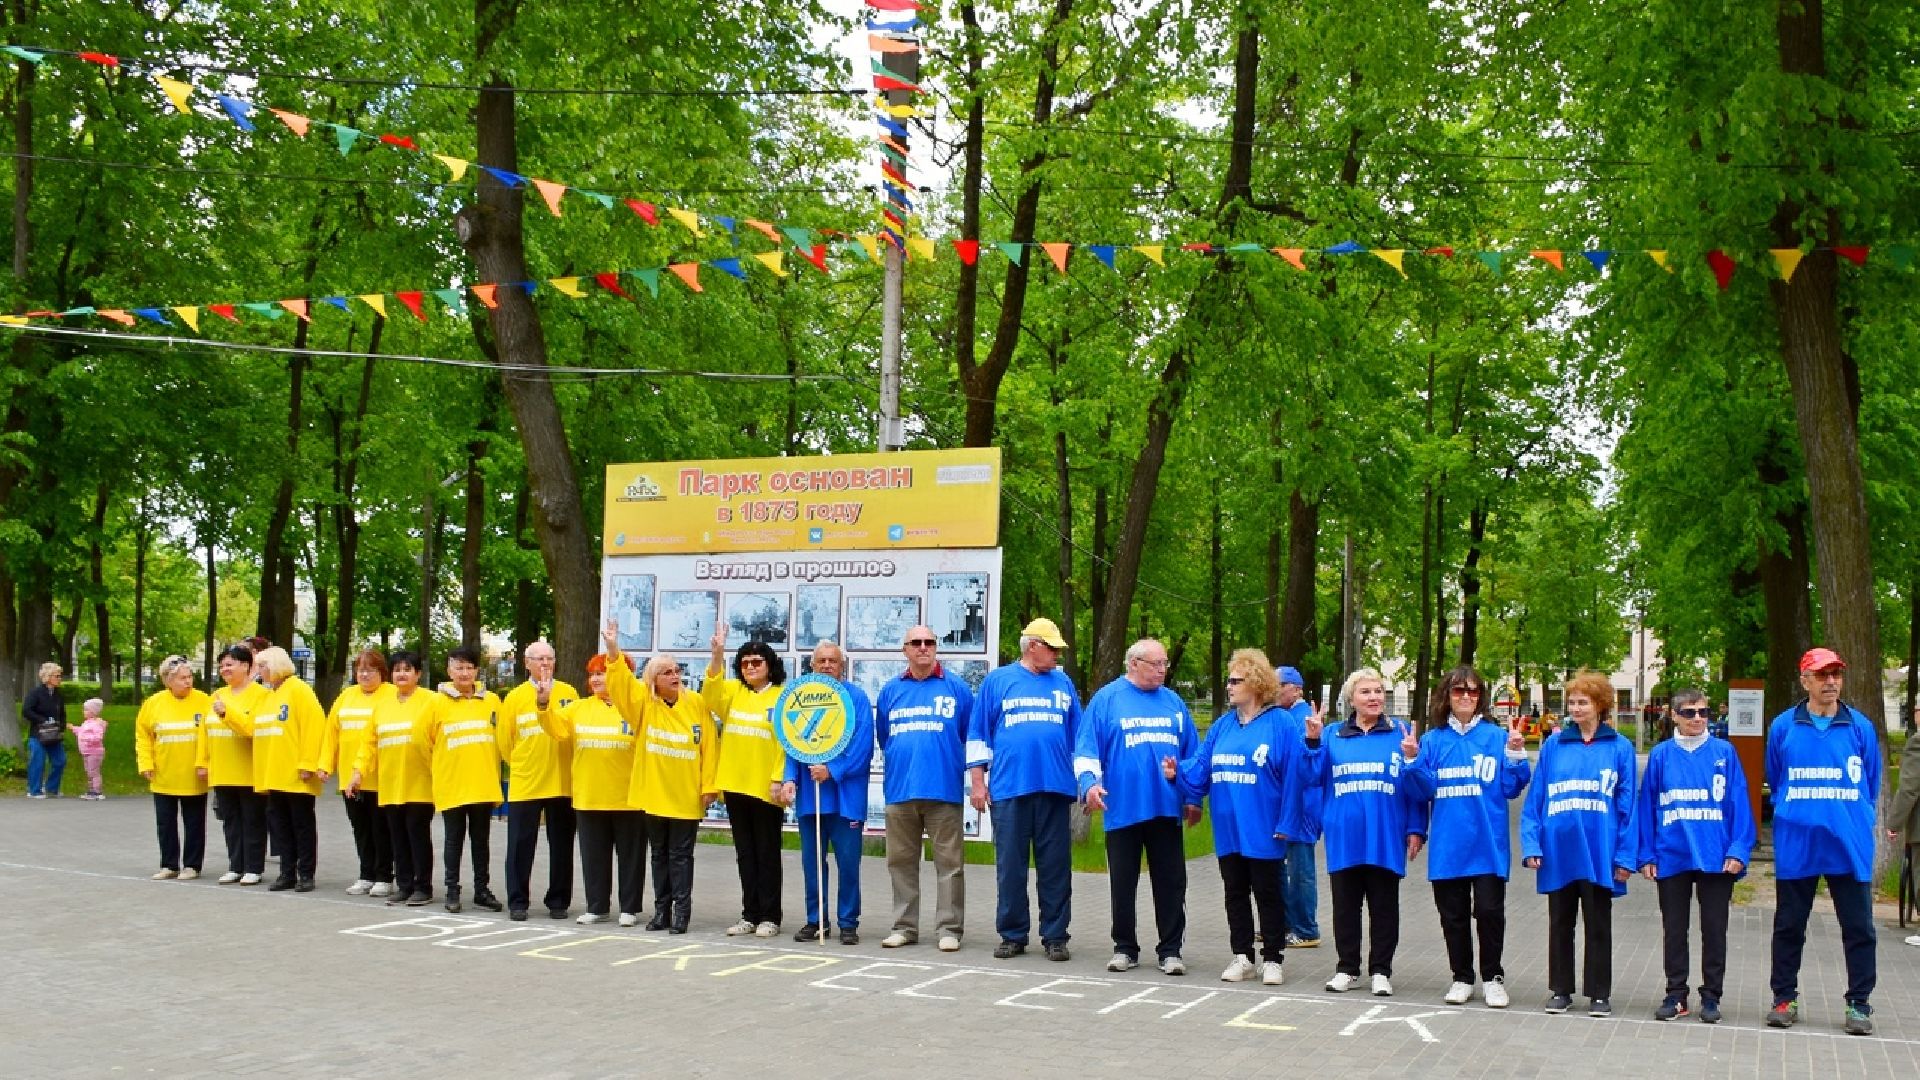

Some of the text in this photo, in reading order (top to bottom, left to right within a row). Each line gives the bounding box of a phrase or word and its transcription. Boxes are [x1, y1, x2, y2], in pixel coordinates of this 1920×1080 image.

[678, 465, 913, 501] Парк основан
[717, 499, 864, 525] в 1875 году
[695, 559, 896, 582] Взгляд в прошлое
[933, 695, 956, 718] 13
[1251, 743, 1270, 767] 4
[1473, 753, 1497, 784] 10
[1847, 755, 1862, 784] 6
[339, 915, 1458, 1043] ВОСКРЕСЕНСК
